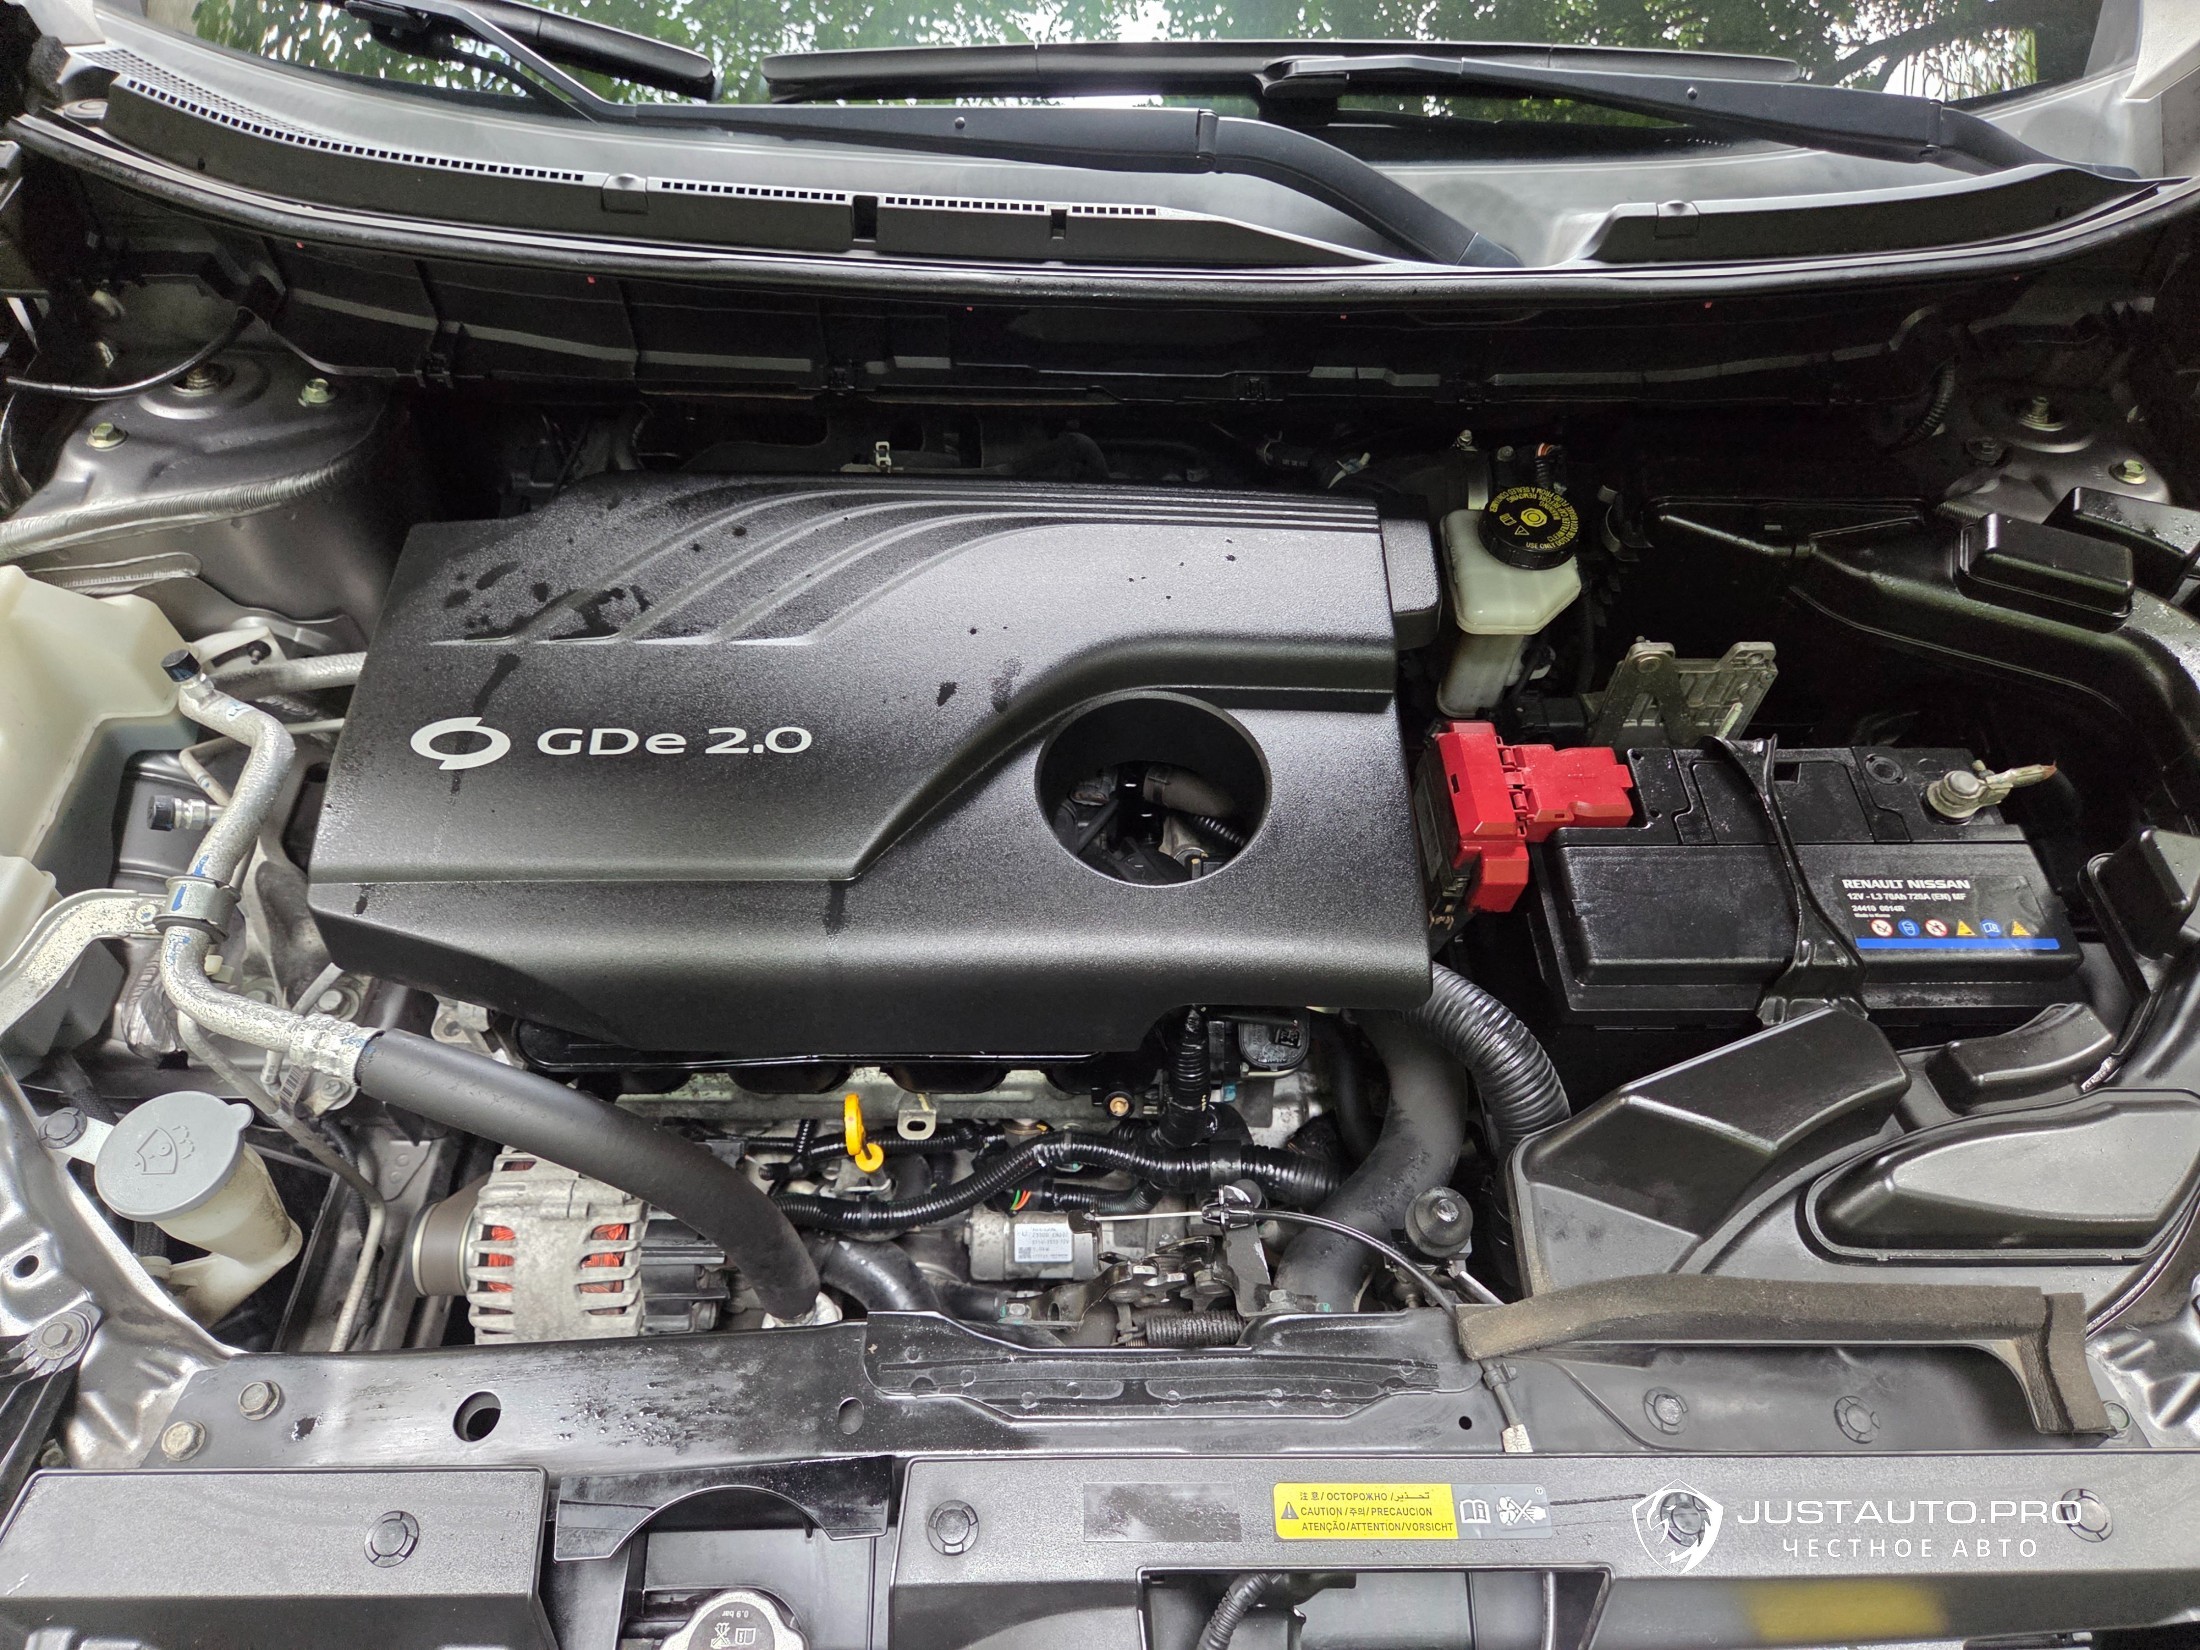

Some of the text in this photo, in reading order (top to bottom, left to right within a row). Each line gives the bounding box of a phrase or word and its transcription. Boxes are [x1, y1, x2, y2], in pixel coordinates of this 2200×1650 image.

[1507, 486, 1530, 495] SEALED
[1535, 487, 1554, 498] FROM
[1538, 494, 1561, 509] BEFORE
[1553, 494, 1569, 508] FLUID
[1525, 541, 1538, 549] USE
[1539, 541, 1556, 550] ONLY
[536, 726, 813, 756] GDe 2.0
[1841, 879, 1971, 889] RENAULT NISSAN
[1326, 1492, 1388, 1501] ОСТОРОЖНО
[1300, 1507, 1343, 1516] CAUTION
[721, 1610, 749, 1618] 0.9 bar
